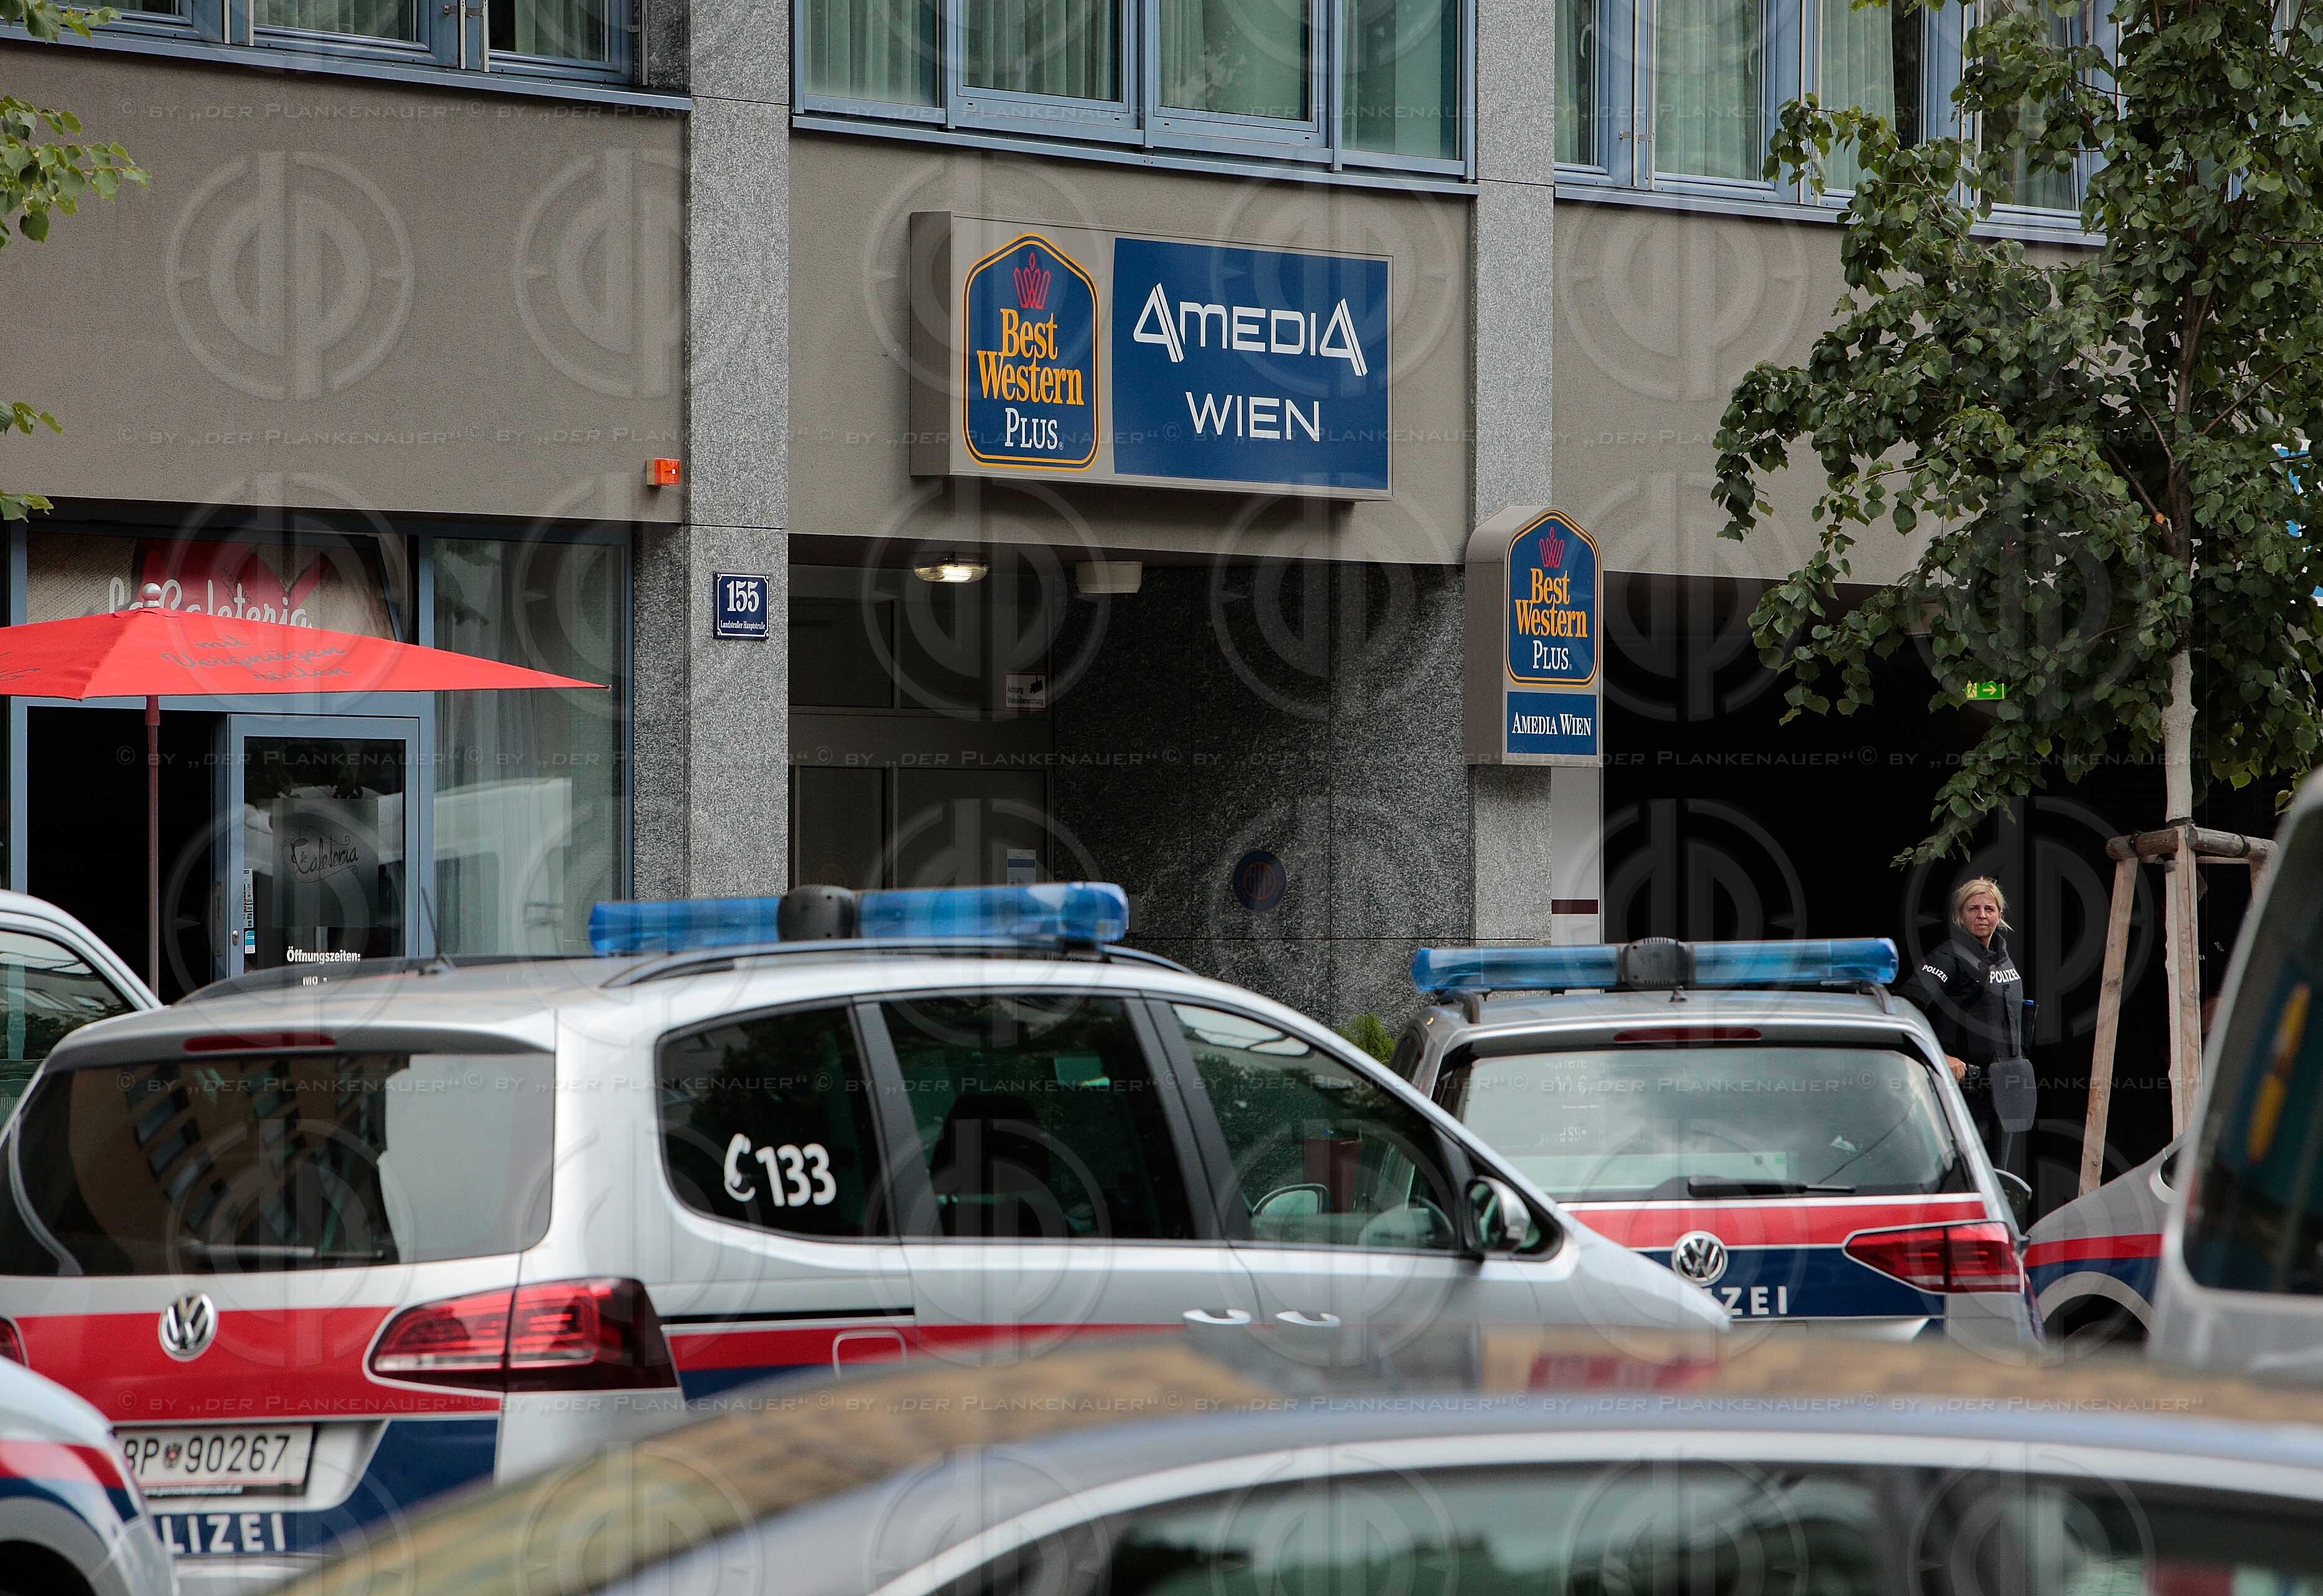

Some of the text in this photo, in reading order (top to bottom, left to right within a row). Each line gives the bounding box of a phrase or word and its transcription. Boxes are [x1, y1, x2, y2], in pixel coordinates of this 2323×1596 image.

[1000, 308, 1058, 360] Best
[977, 345, 1084, 405] Western
[1186, 392, 1320, 441] WIEN
[726, 580, 759, 613] 155
[1531, 568, 1570, 605] Best
[720, 620, 766, 631] Landstraßer Hauptstraße
[1515, 595, 1588, 638] Western
[286, 946, 361, 964] Öffnungszeiten:
[1922, 964, 1948, 983] POLIZEI
[1989, 968, 2021, 984] POLIZEI
[756, 1143, 836, 1207] 133
[185, 1435, 291, 1473] 90267
[161, 1512, 286, 1554] LIZEI
